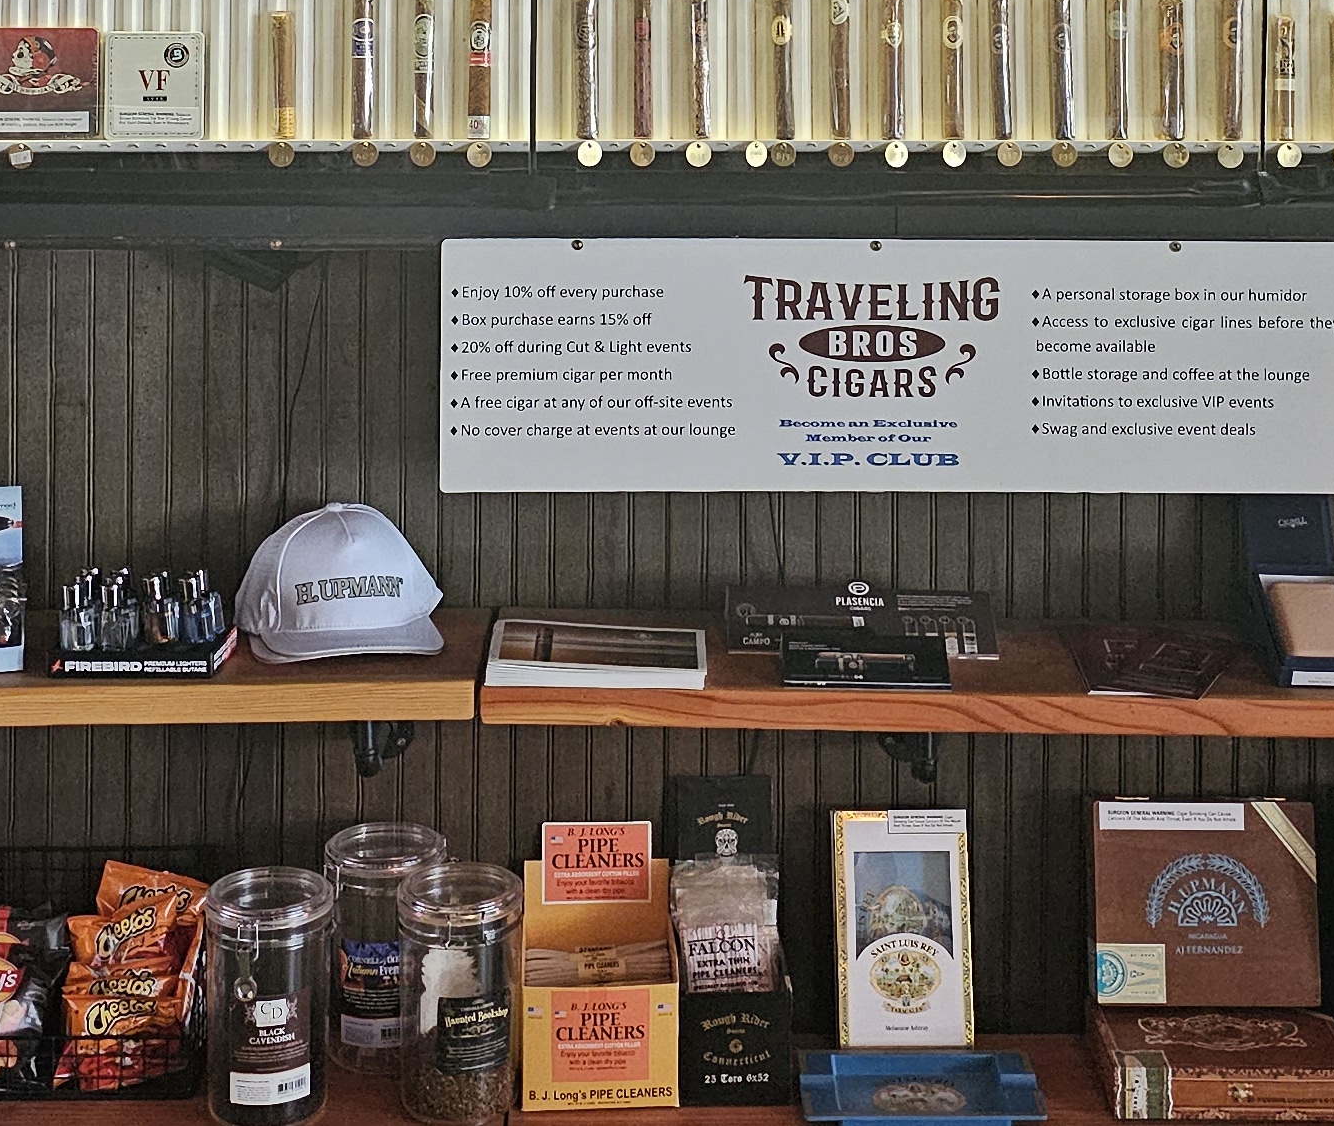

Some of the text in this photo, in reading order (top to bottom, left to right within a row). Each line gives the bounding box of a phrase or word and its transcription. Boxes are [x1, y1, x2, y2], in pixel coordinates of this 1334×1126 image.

[139, 69, 170, 91] VF
[462, 284, 664, 301] Enjoy 10% off every purchase
[743, 274, 1001, 322] TRAVELING
[1041, 287, 1308, 304] A personal storage box in our humidor
[462, 312, 653, 329] Box purchase earns 15% off
[1041, 315, 1089, 328] Access
[1093, 316, 1109, 328] to
[1114, 315, 1176, 329] exclusive
[1181, 318, 1215, 332] cigar
[1220, 315, 1253, 329] lines
[1258, 315, 1304, 329] before
[461, 339, 692, 356] 20% off during Cut & Light events
[828, 331, 917, 356] BROS
[1036, 339, 1156, 353] become available
[461, 367, 672, 384] Free premium cigar per month
[806, 360, 938, 398] CIGARS
[1042, 366, 1310, 384] Bottle storage and coffee at the lounge
[460, 394, 733, 412] A free cigar at any of our off-site events
[1042, 394, 1275, 409] Invitations to exclusive VIP events
[461, 422, 736, 439] No cover charge at events at our lounge
[779, 419, 845, 428] Become
[872, 419, 958, 428] Exclusive
[1041, 421, 1256, 438] Swag and exclusive event deals
[806, 433, 932, 443] Member of Our
[776, 452, 960, 467] V.I.P. CLUB
[835, 596, 884, 607] PLASENCIA
[65, 661, 142, 672] FIREBIRD
[568, 828, 576, 836] B.
[578, 838, 619, 853] PIPE
[552, 853, 644, 869] CLEANERS
[688, 937, 756, 958] FALCON
[870, 939, 939, 958] SAINT LUIS REY
[1186, 946, 1243, 954] FERNANDEZ
[697, 956, 750, 968] EXTRA THIN
[249, 1033, 295, 1045] CAVENDISH
[258, 1027, 286, 1036] BLACK
[529, 1087, 672, 1102] B. J. Long's PIPE CLEANERS
